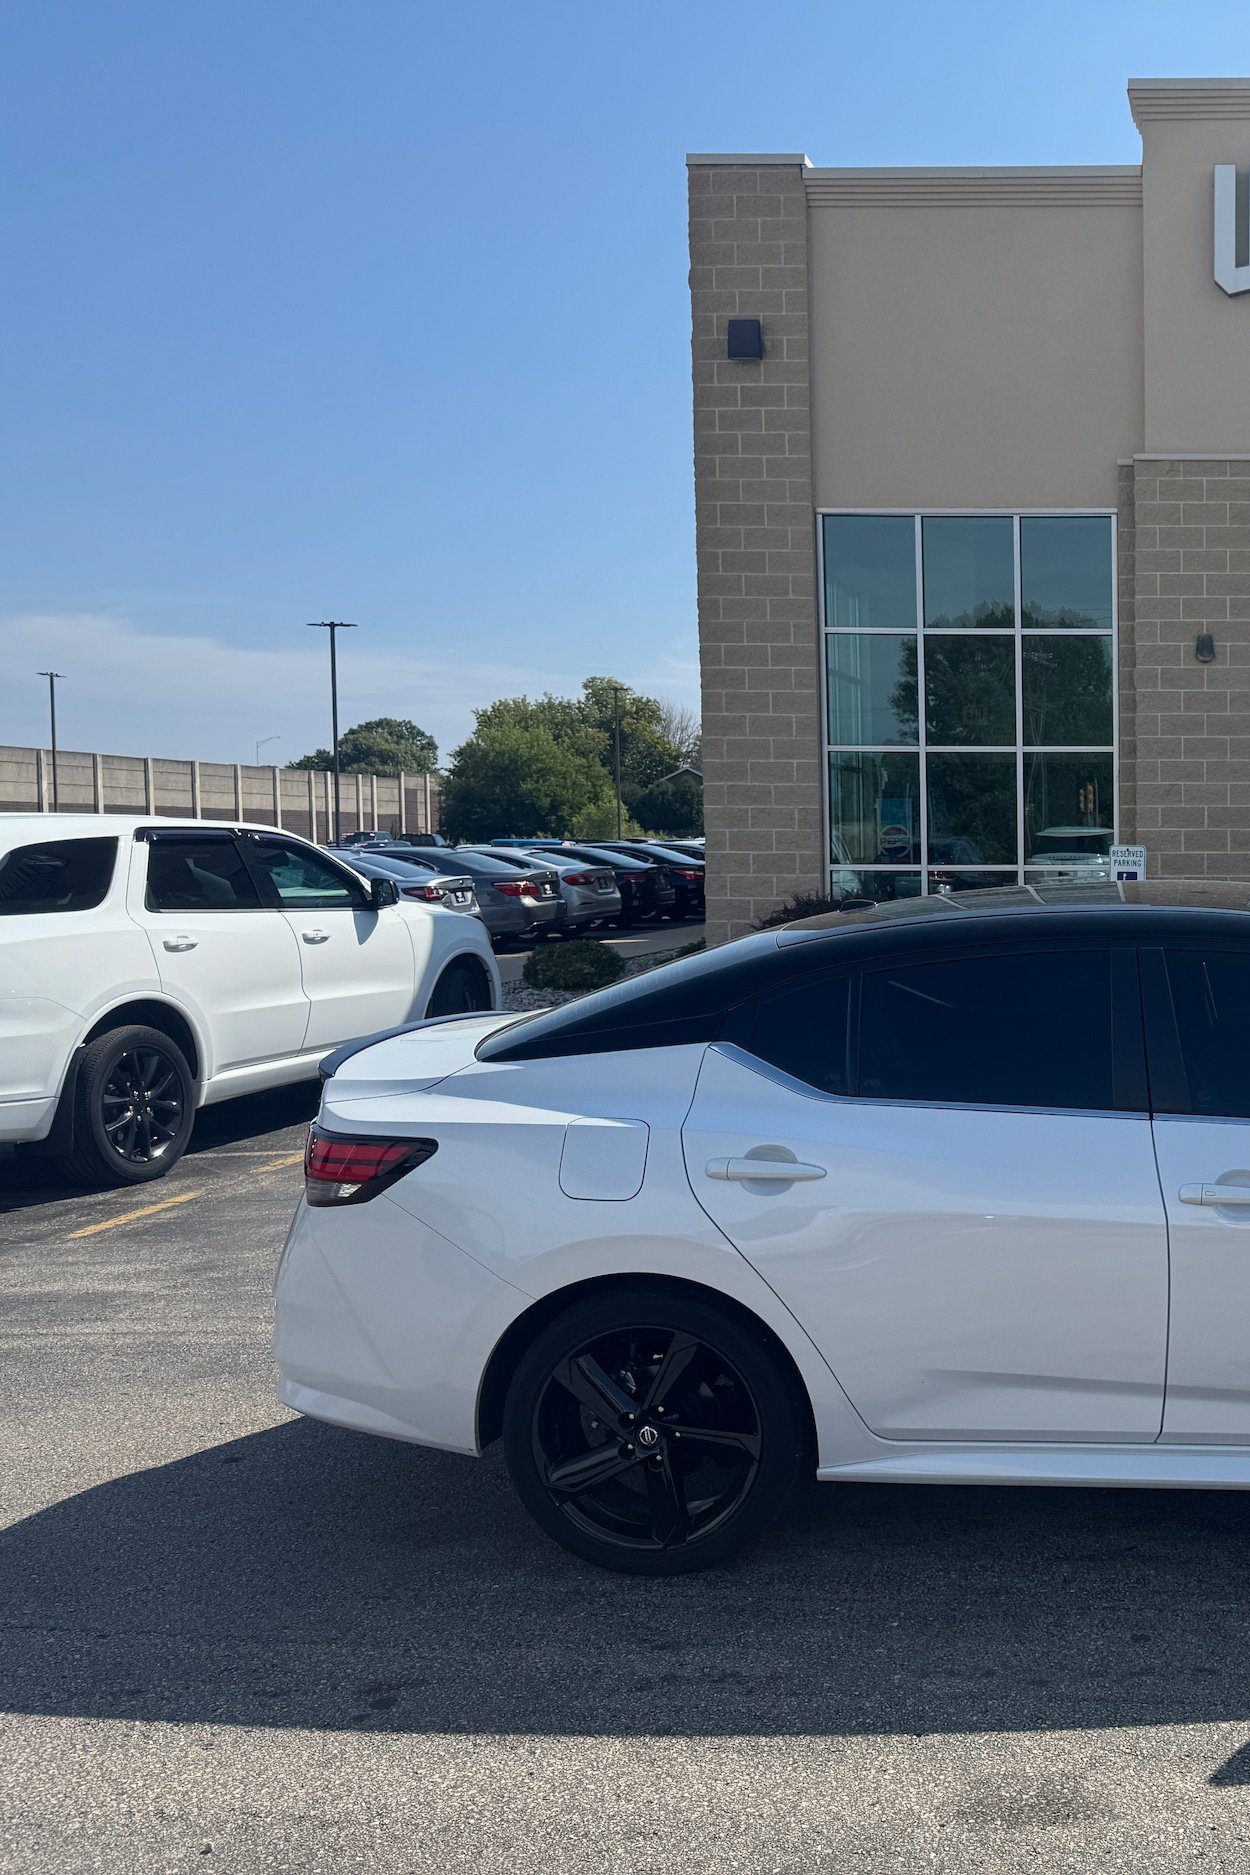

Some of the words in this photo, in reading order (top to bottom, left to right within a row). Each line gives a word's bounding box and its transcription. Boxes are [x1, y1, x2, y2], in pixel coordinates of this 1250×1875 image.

[966, 706, 985, 720] EXIT
[1111, 849, 1144, 858] RESERVED
[1113, 859, 1142, 868] PARKING
